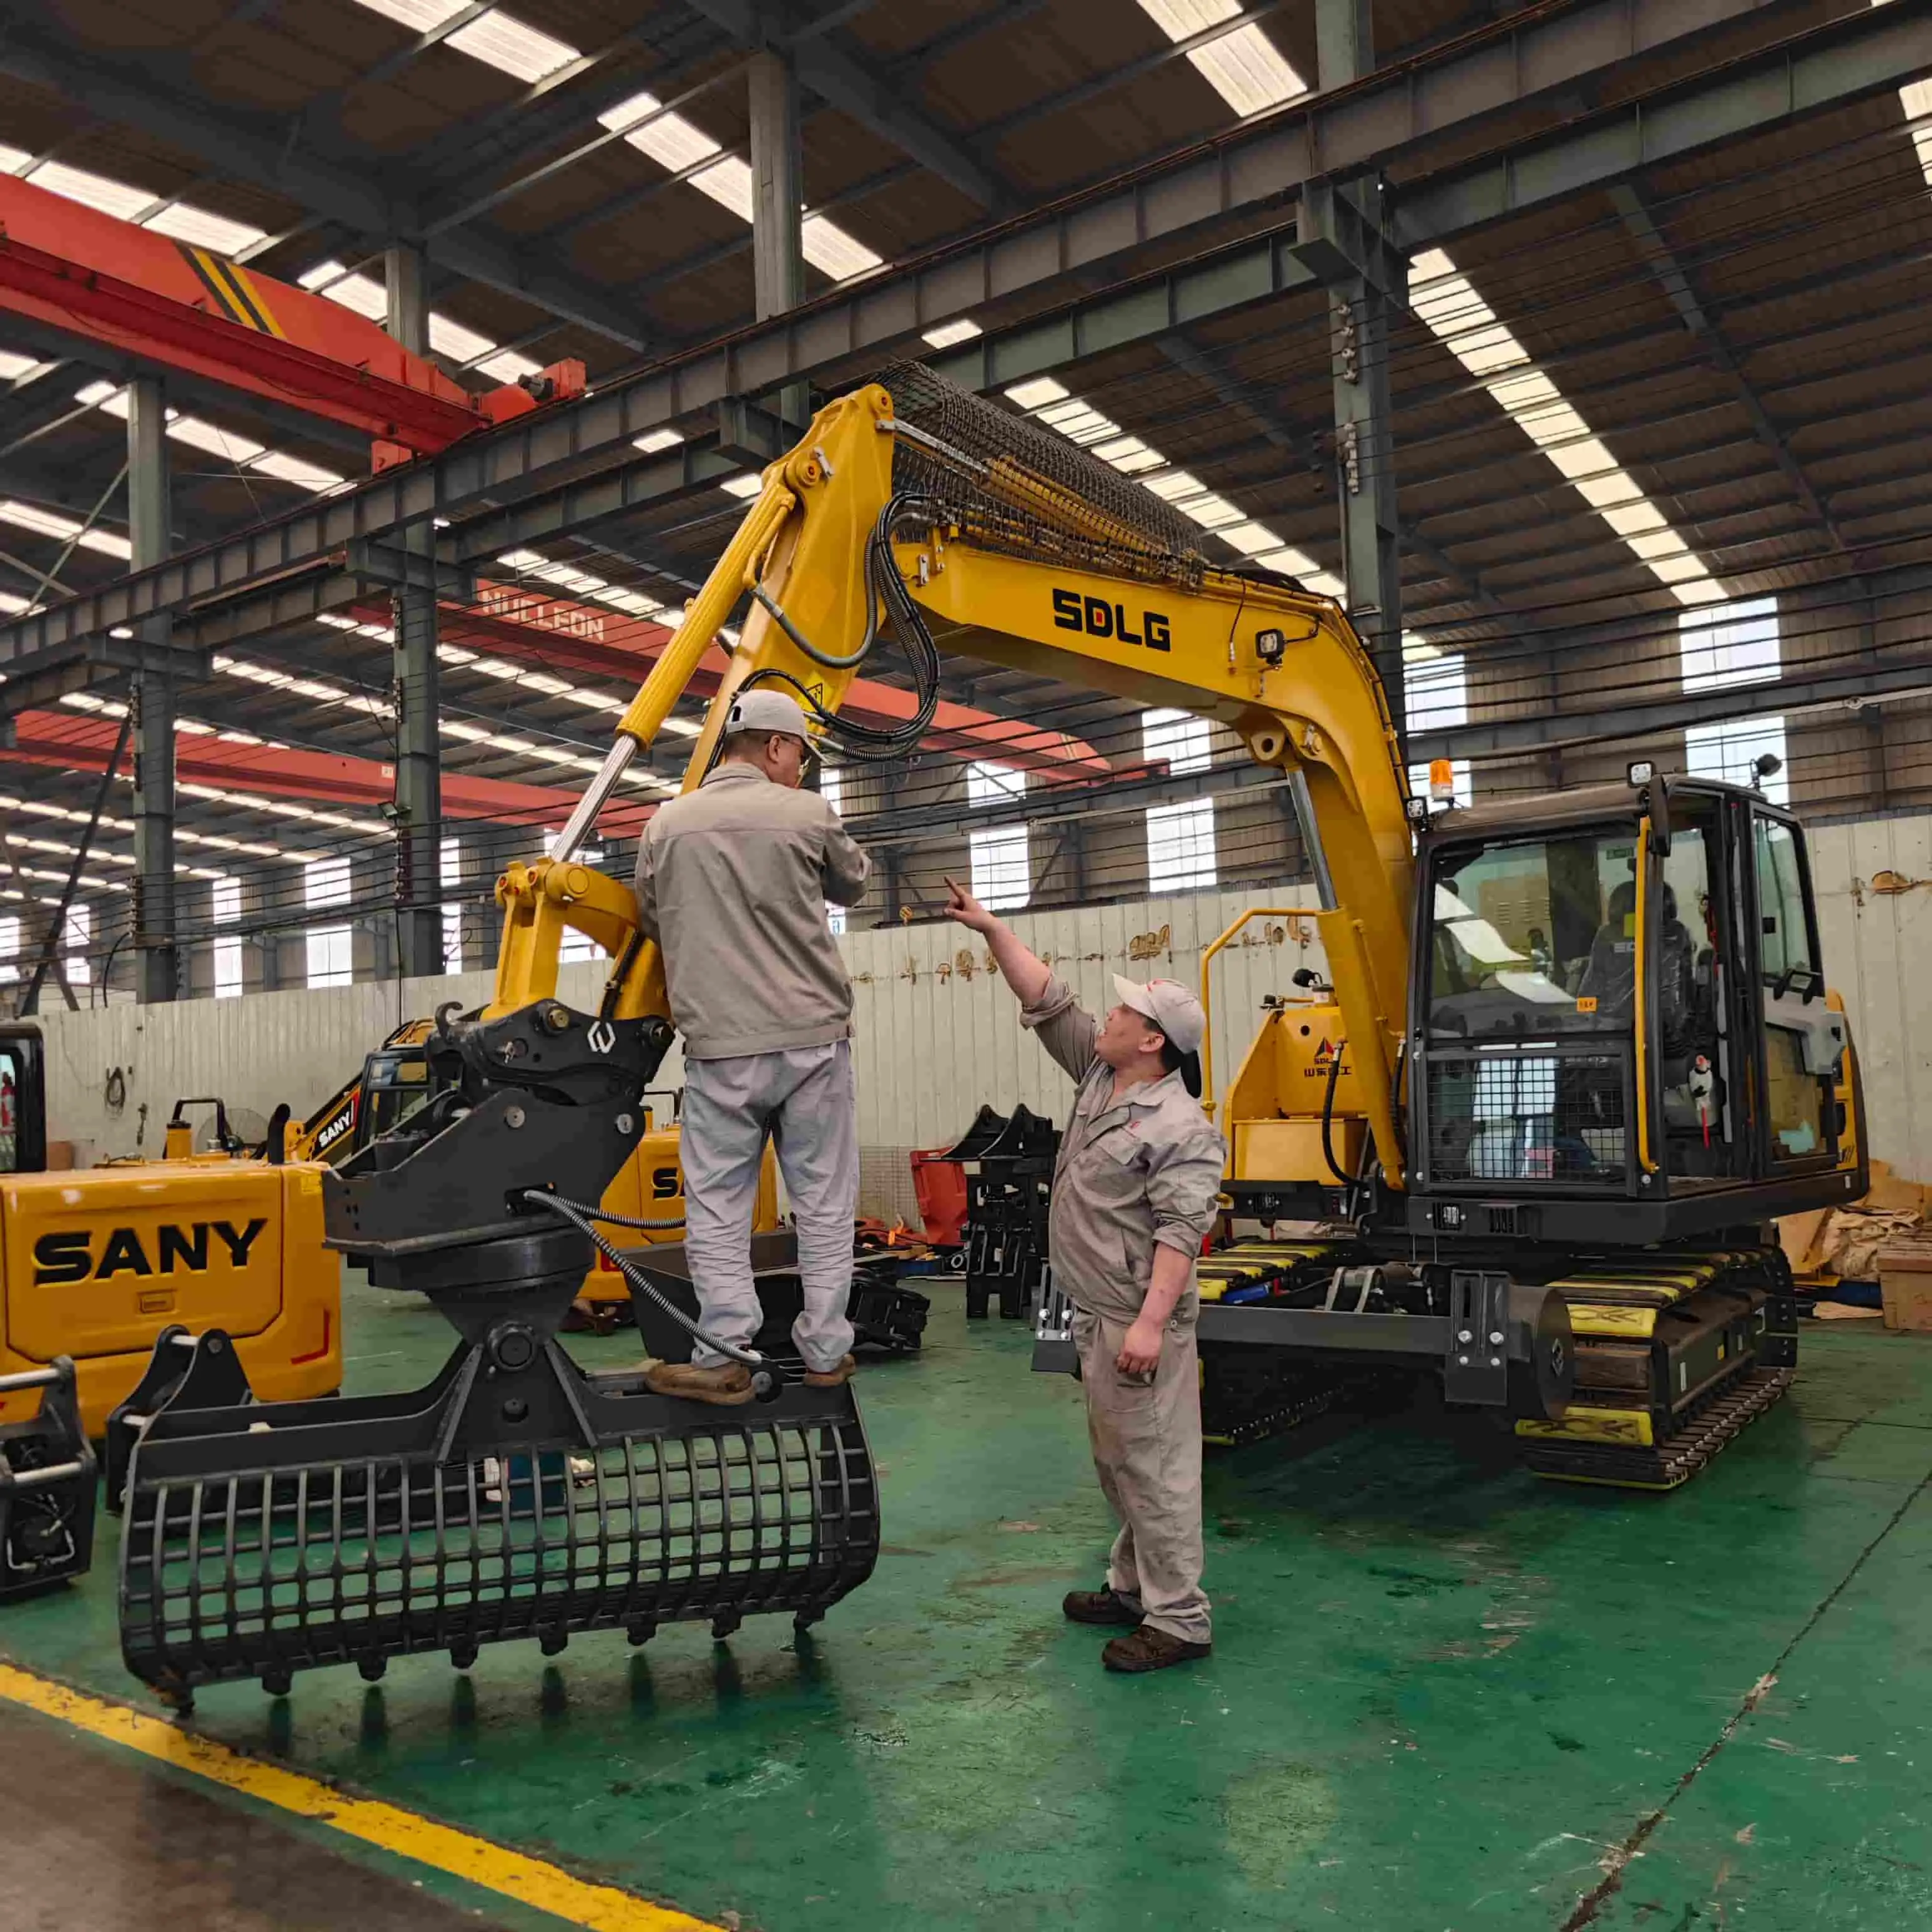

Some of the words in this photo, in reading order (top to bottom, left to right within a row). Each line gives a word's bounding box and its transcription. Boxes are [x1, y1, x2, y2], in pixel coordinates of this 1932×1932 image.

[1052, 588, 1171, 652] SDLG
[1304, 1066, 1352, 1077] 山东工
[319, 1111, 350, 1147] SANY
[33, 1219, 268, 1287] SANY
